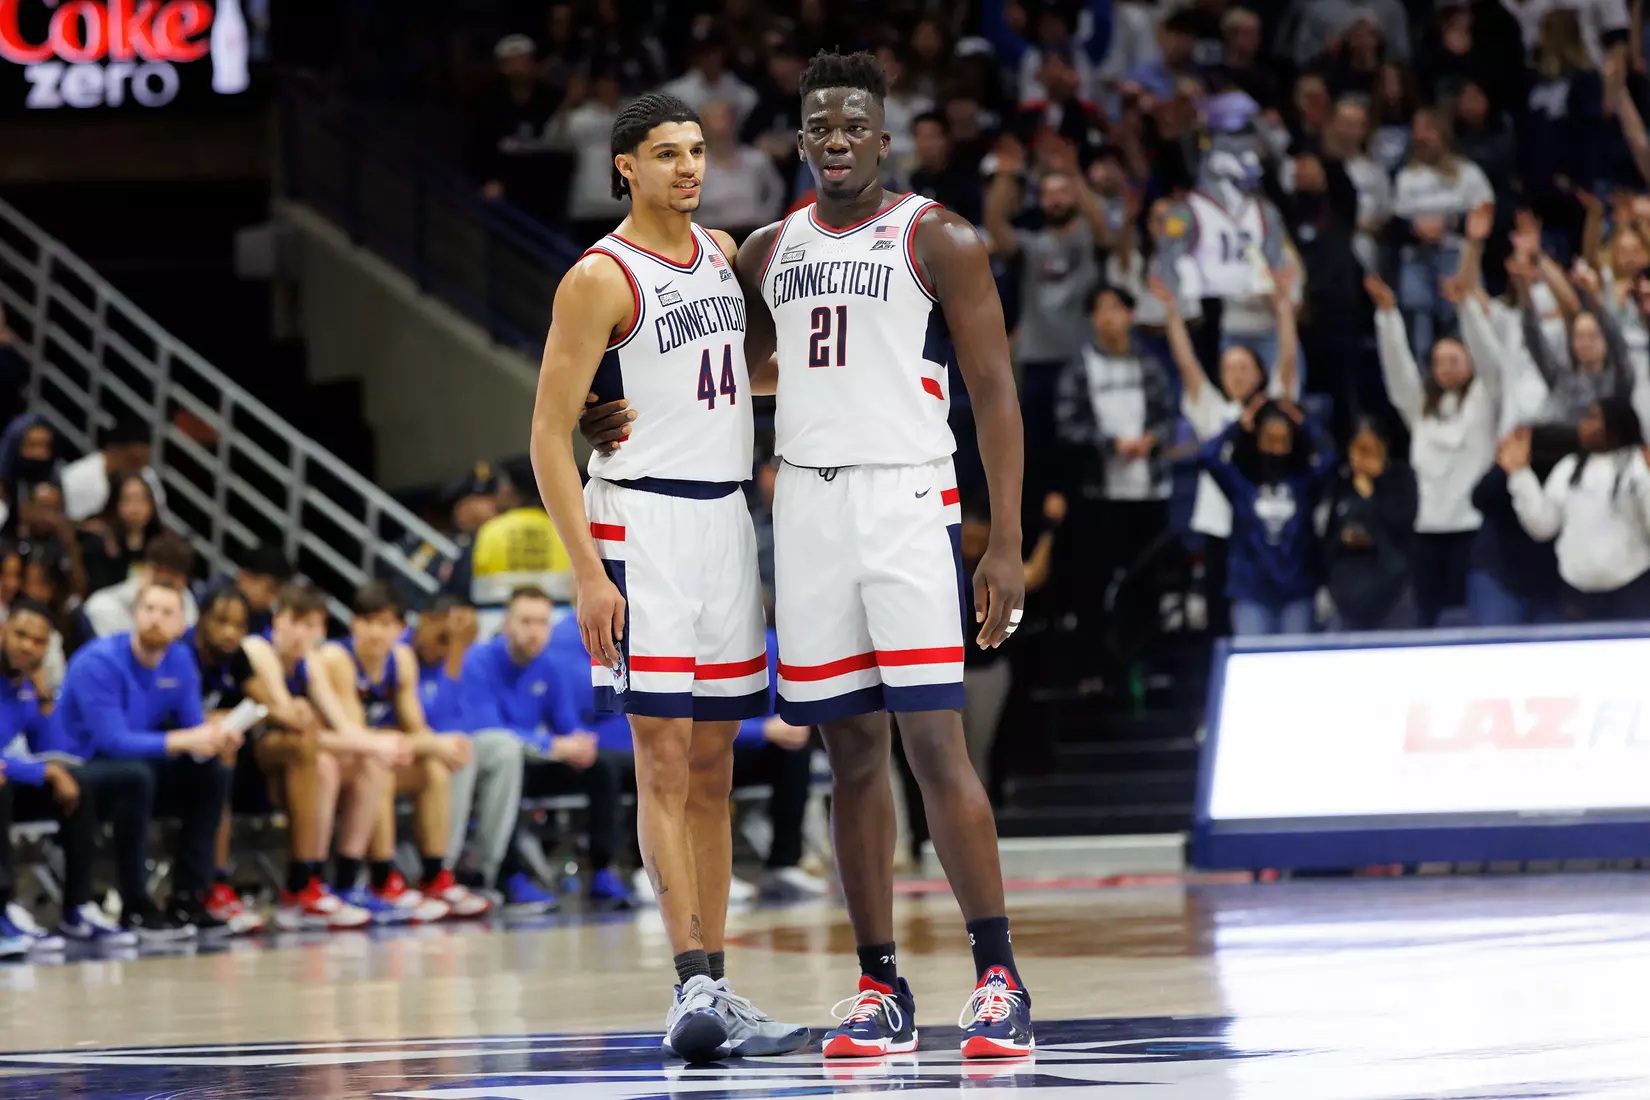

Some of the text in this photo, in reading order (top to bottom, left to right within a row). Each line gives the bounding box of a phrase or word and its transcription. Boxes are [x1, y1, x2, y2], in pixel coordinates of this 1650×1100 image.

[0, 0, 213, 64] Coke
[24, 60, 180, 109] zero
[773, 260, 894, 309] CONNECTICUT
[808, 304, 848, 369] 21
[697, 343, 737, 411] 44
[1402, 697, 1581, 753] LAZ
